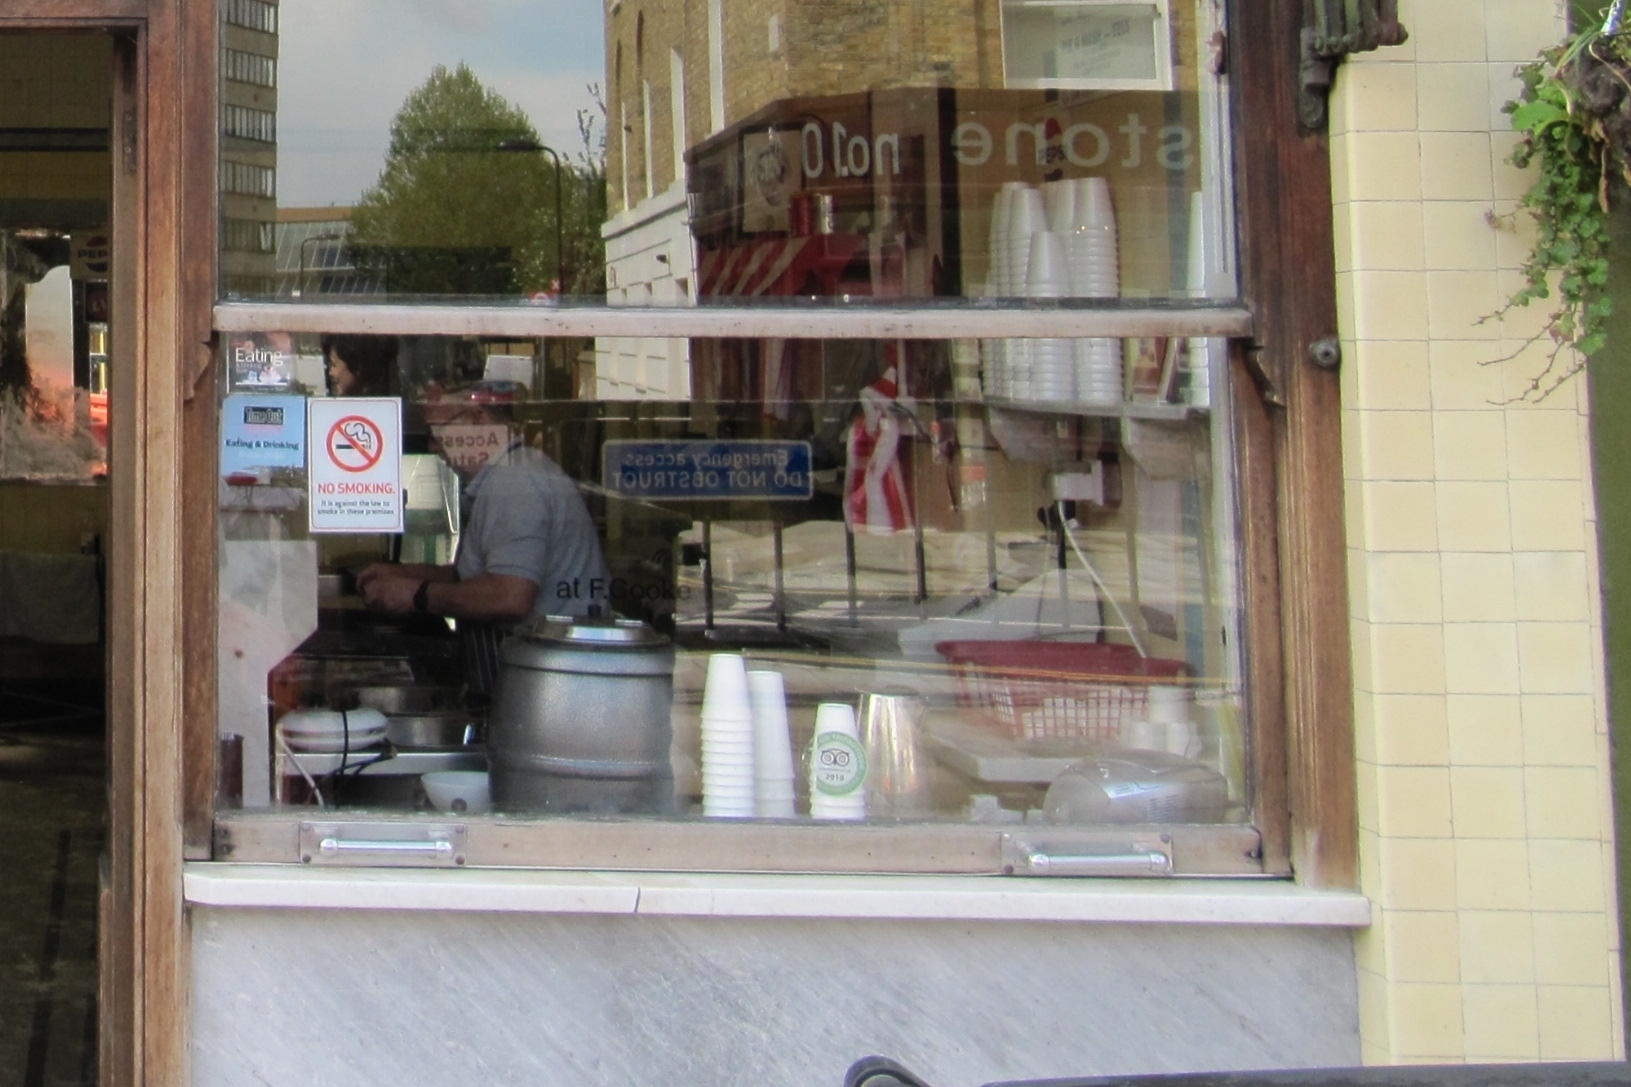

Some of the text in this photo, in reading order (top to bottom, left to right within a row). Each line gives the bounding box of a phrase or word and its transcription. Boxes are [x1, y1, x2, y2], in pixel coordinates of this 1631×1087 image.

[77, 249, 108, 259] PEP
[235, 347, 284, 366] Eating
[226, 437, 299, 451] Eating & Drinking
[318, 482, 335, 494] NO
[335, 500, 358, 509] against
[556, 578, 580, 600] at
